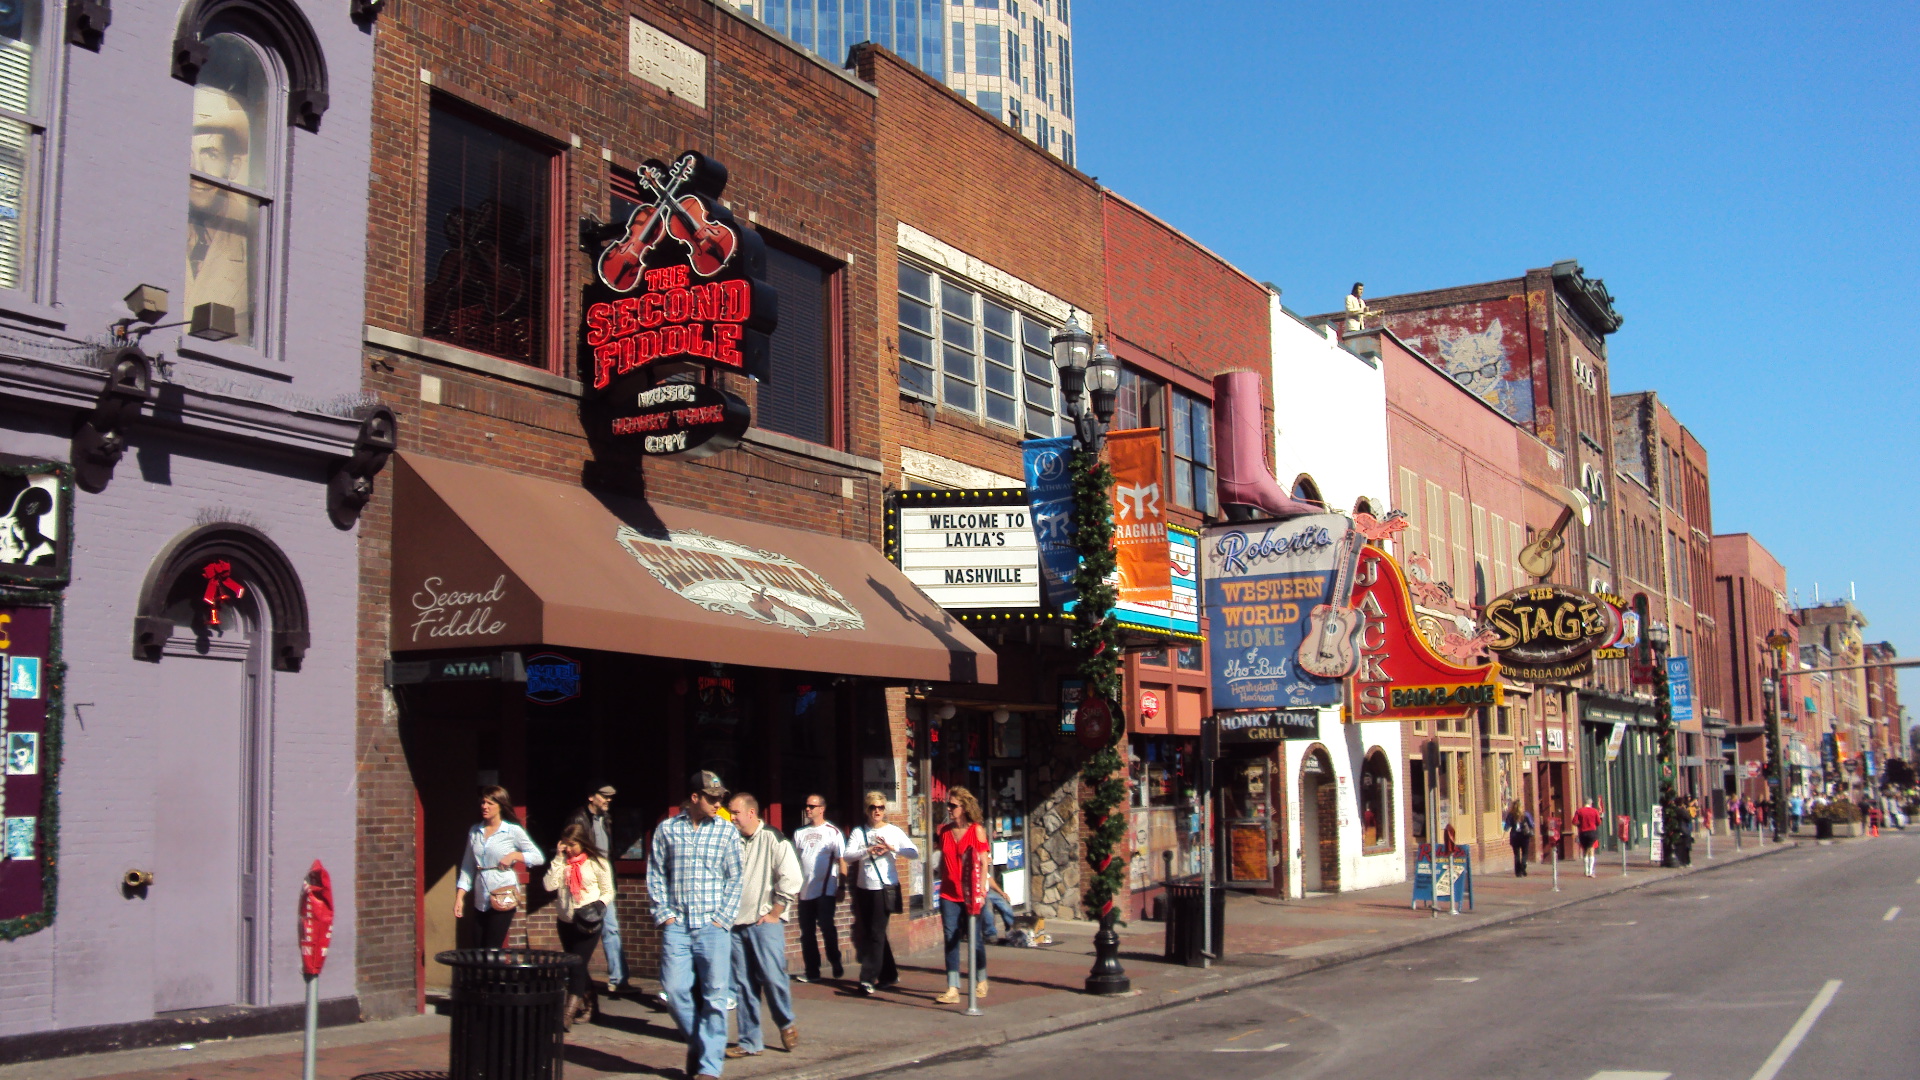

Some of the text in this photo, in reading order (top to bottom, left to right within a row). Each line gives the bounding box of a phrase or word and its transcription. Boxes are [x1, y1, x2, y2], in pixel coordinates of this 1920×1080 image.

[645, 264, 690, 291] THE
[587, 279, 750, 346] SECOND
[593, 323, 743, 390] FIDDLE
[637, 384, 695, 408] MUSIC
[612, 404, 724, 435] HONKY TONK
[644, 430, 688, 453] CITY
[1027, 483, 1075, 493] HEALTHWAY
[930, 513, 1025, 529] WELCOME TO
[1116, 522, 1165, 539] RAGNAR
[946, 531, 1005, 547] LAYLA'S
[1217, 527, 1332, 575] Robert's
[628, 538, 746, 593] SECOND
[944, 568, 1021, 584] NASHVILLE
[412, 574, 506, 611] Second
[1220, 576, 1326, 603] WESTERN
[1528, 588, 1554, 600] THE
[410, 606, 507, 642] Fiddle
[1221, 602, 1300, 627] WORLD
[1486, 599, 1605, 650] STAGE
[1224, 626, 1286, 649] HOME
[1355, 557, 1394, 716] JACKS
[1247, 647, 1259, 664] of
[1596, 648, 1625, 660] OTS
[442, 661, 490, 676] ATM
[1224, 656, 1287, 677] Sho-Bud
[1501, 661, 1588, 679] ON BROADWAY
[1221, 712, 1316, 731] HONKY TONK
[1248, 728, 1289, 740] GRILL
[1525, 747, 1541, 755] ATM
